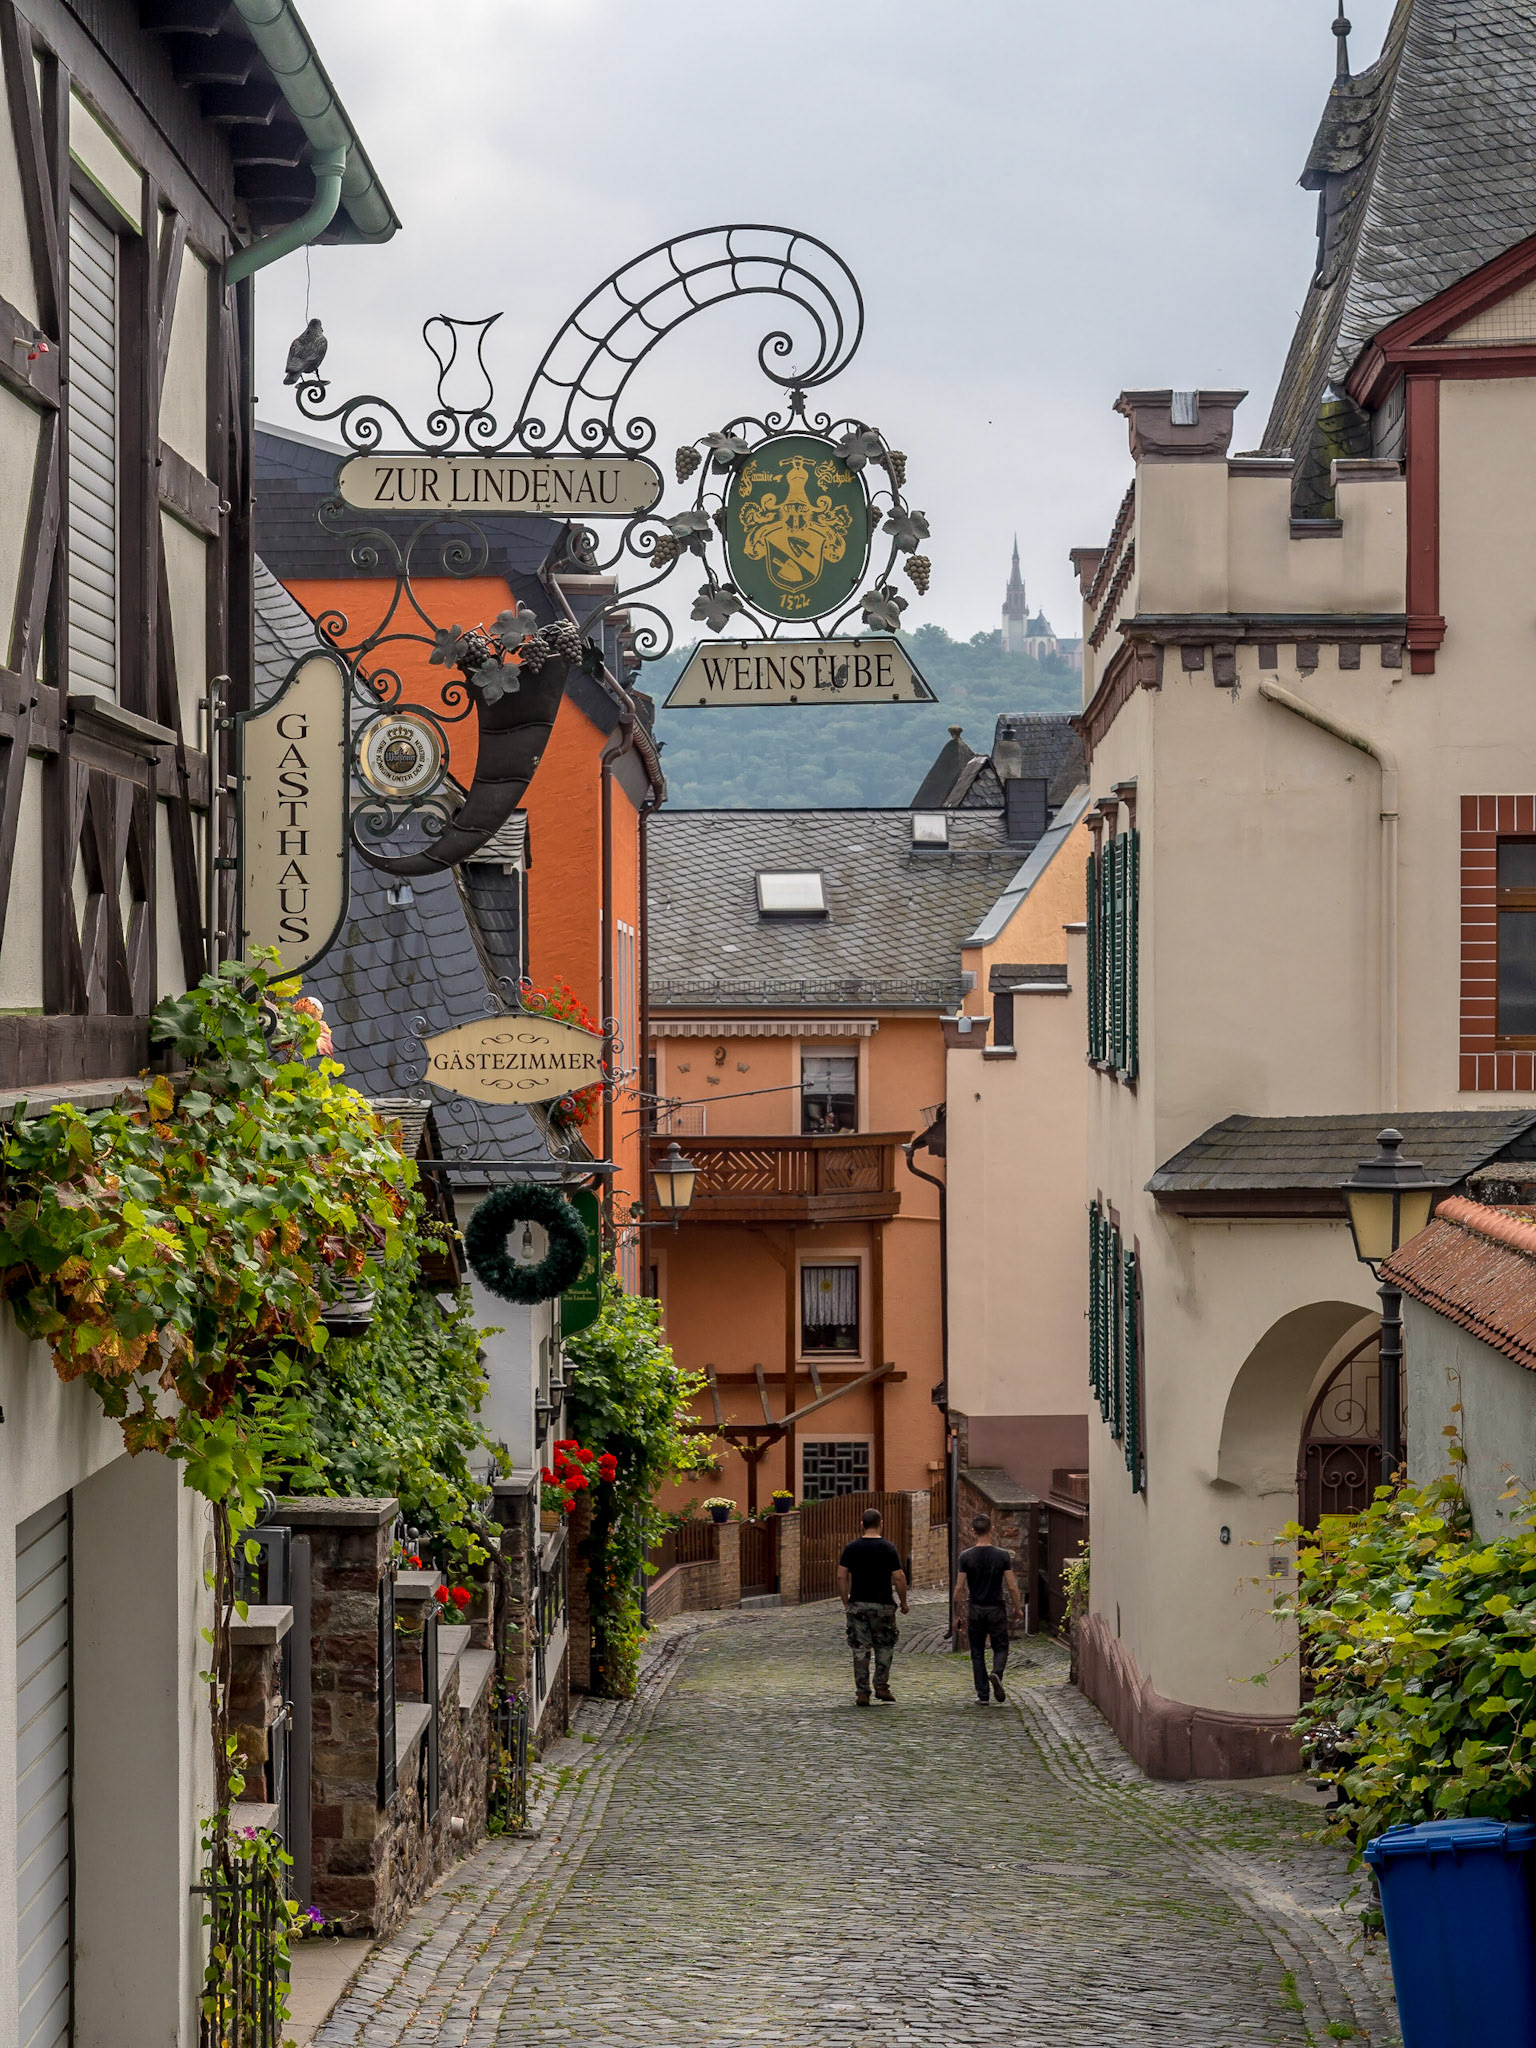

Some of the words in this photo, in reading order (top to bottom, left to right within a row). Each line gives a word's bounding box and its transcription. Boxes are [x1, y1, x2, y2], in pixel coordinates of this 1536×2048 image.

[374, 467, 441, 502] ZUR
[450, 467, 621, 504] LINDENAU
[700, 653, 896, 692] WEINSTUBE
[376, 740, 386, 753] EINE
[392, 774, 414, 782] UNTER
[412, 763, 424, 777] DEN
[276, 713, 310, 944] GASTHAUS
[433, 1049, 598, 1071] GÄSTEZIMMER
